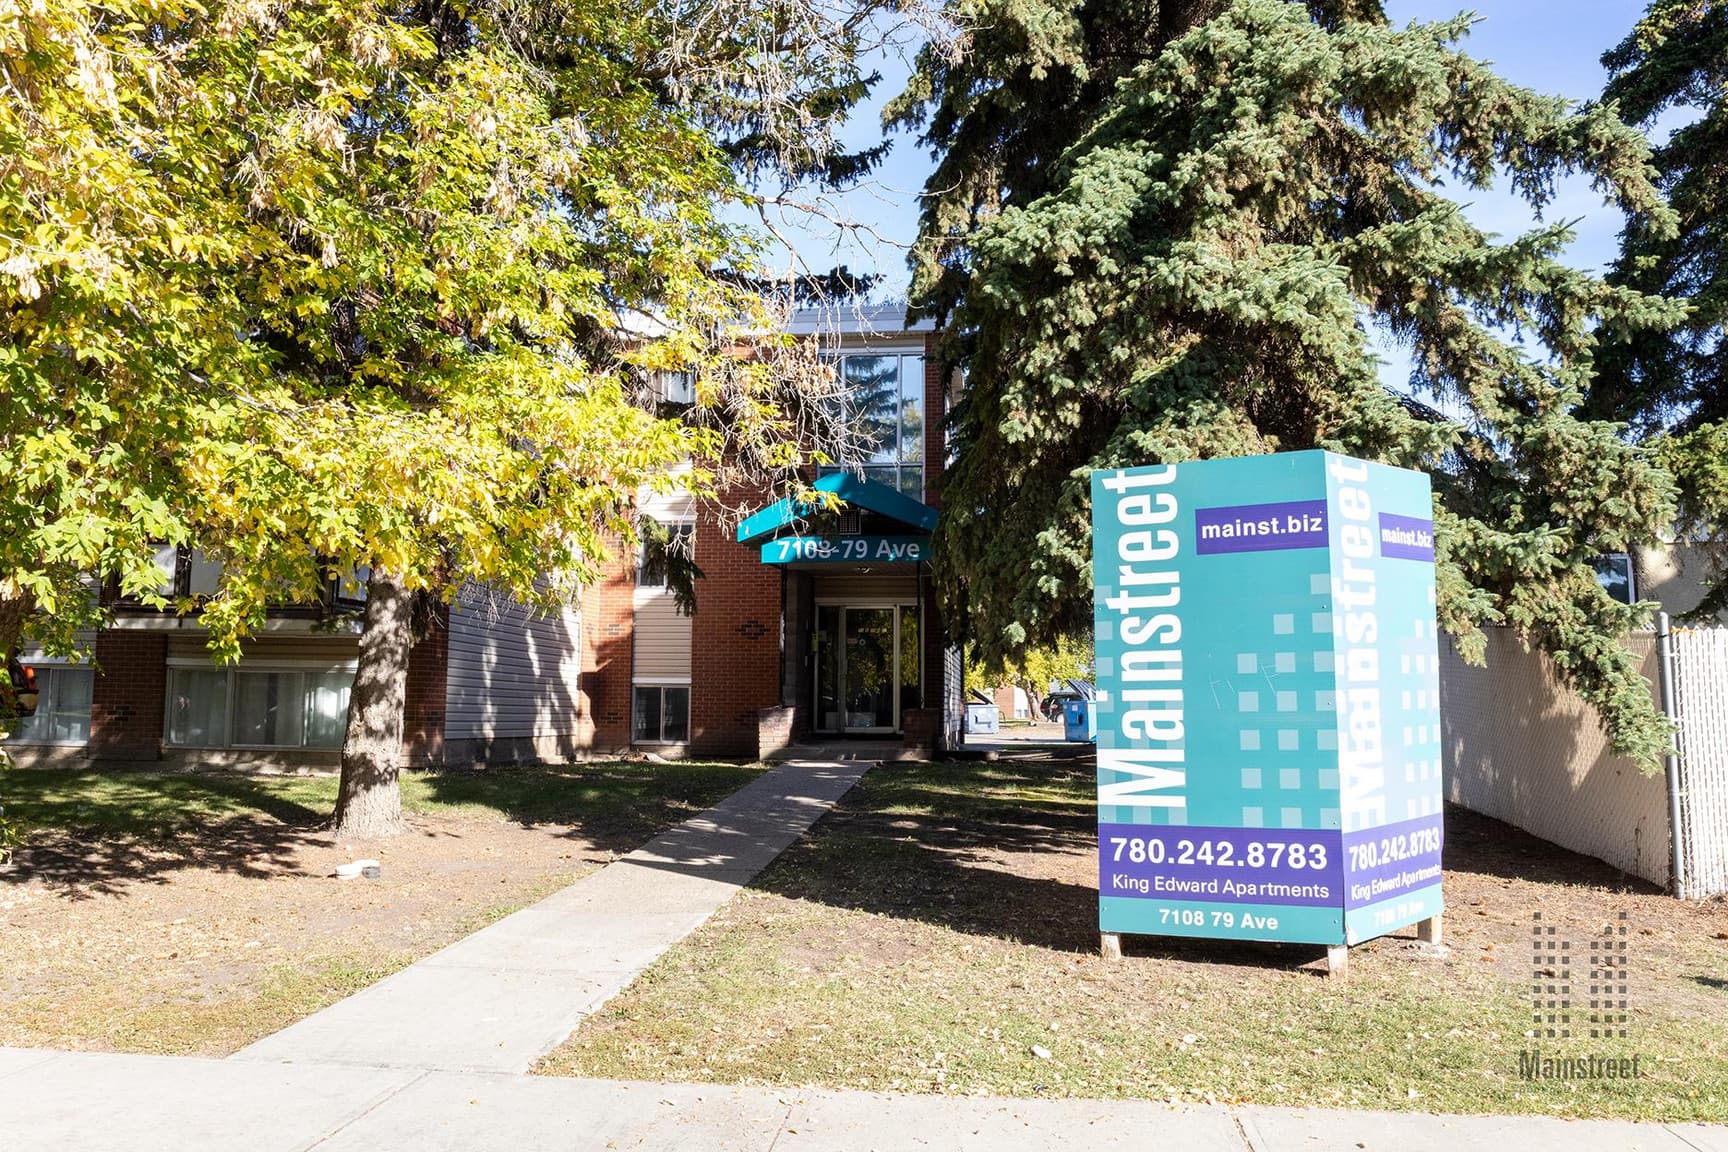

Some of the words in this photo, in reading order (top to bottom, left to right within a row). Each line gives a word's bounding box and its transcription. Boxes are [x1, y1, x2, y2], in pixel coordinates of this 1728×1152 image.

[1201, 514, 1323, 539] mainst.biz
[1381, 527, 1432, 548] mainst.biz
[876, 538, 920, 560] Ave
[1096, 464, 1187, 808] Mainstreet
[1110, 838, 1328, 870] 780.242.8783
[1348, 828, 1440, 872] 780.242.8783
[1112, 874, 1149, 893] King
[1154, 876, 1218, 894] Edward
[1222, 879, 1330, 898] Apartments
[1351, 884, 1371, 901] King
[1371, 873, 1401, 895] Edward
[1159, 909, 1205, 925] 7108
[1210, 911, 1235, 928] 79
[1240, 913, 1279, 930] Ave
